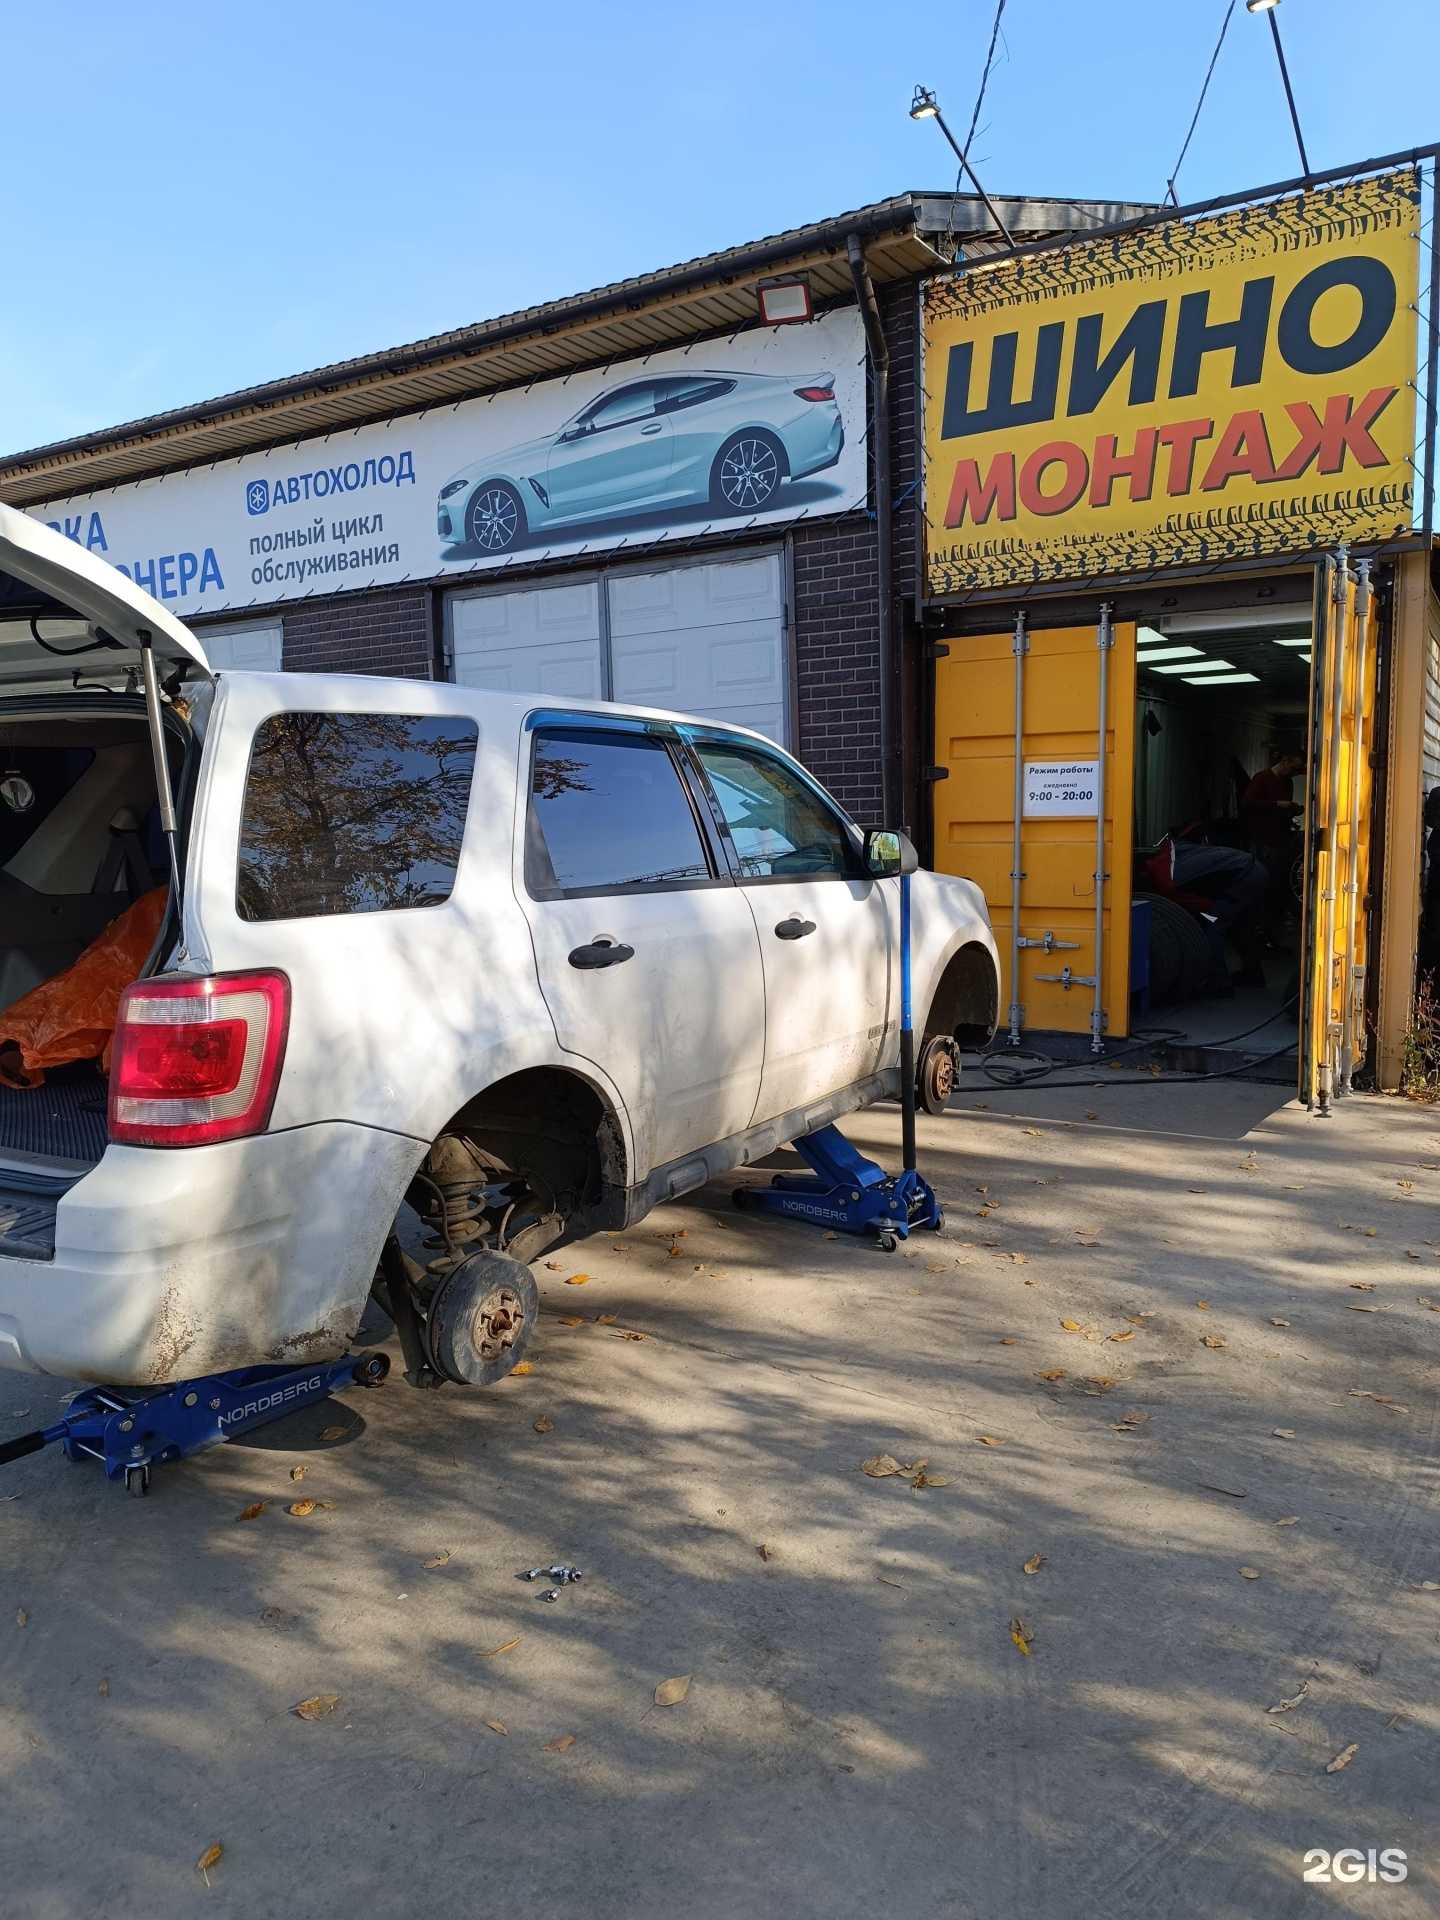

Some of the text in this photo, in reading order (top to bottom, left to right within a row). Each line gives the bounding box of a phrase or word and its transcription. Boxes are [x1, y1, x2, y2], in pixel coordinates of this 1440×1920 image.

[941, 255, 1397, 440] ШИНО
[272, 451, 415, 506] АВТОХОЛОД
[943, 385, 1400, 530] МОНТАЖ
[250, 513, 384, 556] полный цикл
[251, 543, 400, 585] обслуживания
[1029, 766, 1093, 776] Режим работы
[1029, 791, 1053, 801] 9:00
[1062, 790, 1093, 801] 20:00
[782, 1199, 849, 1222] NORDBERG
[217, 1375, 322, 1429] NORDBERG
